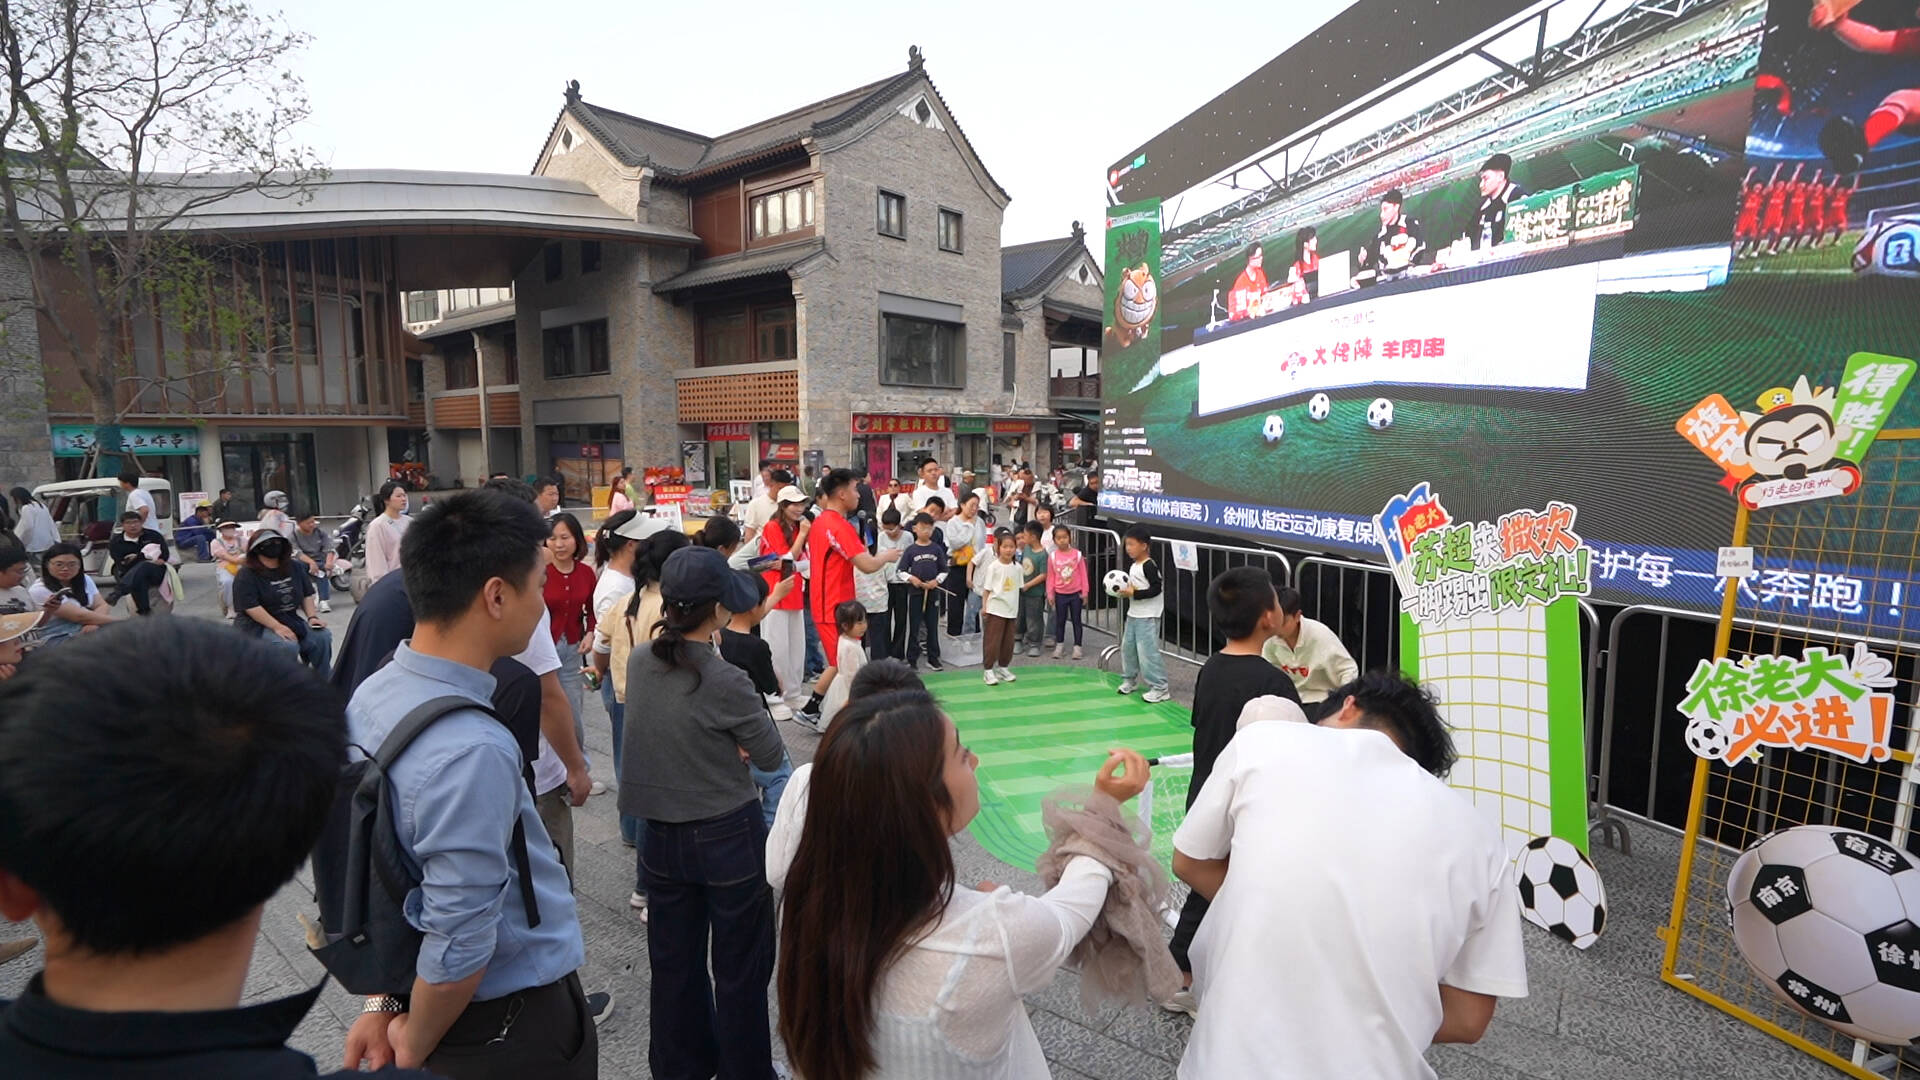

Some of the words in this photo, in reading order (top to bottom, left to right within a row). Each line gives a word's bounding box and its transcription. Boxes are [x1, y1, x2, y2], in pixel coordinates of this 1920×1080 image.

[1382, 337, 1445, 359] 羊肉串
[1402, 507, 1440, 542] 徐老大
[1412, 504, 1578, 586] 苏超来撒欢
[1402, 548, 1589, 618] 一脚踢出限定礼！
[1681, 651, 1866, 720] 徐老大
[1844, 835, 1898, 869] 宿迁
[1756, 875, 1799, 908] 南京
